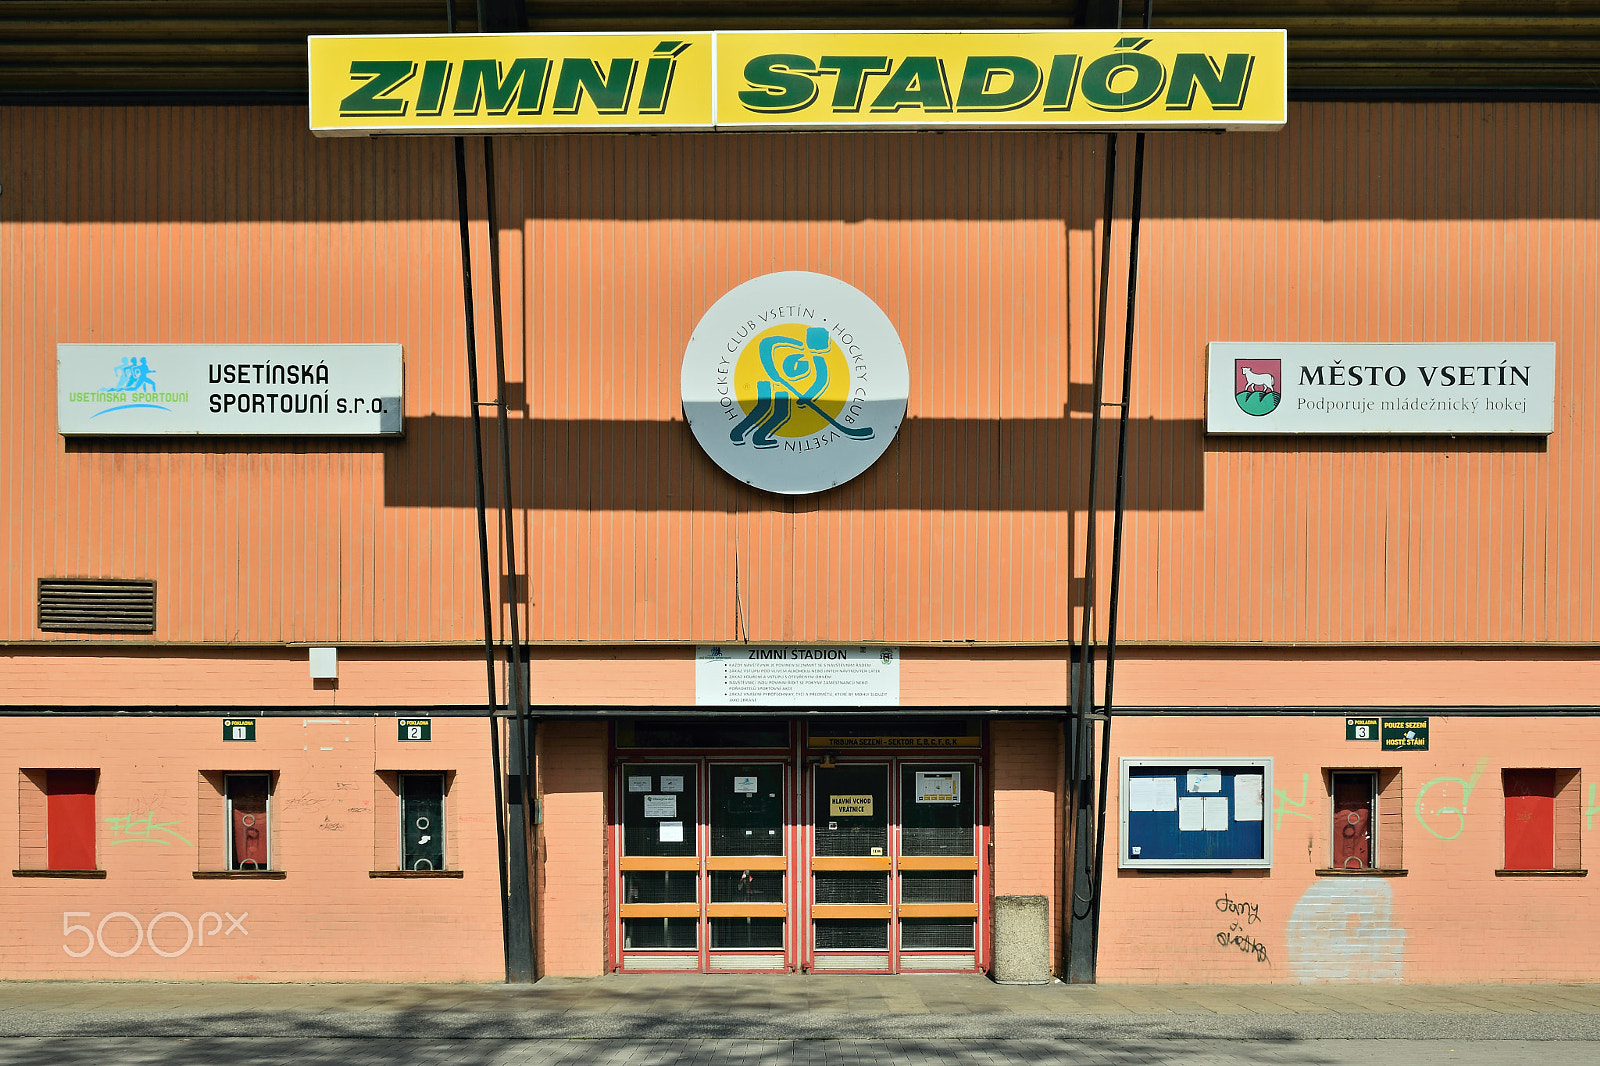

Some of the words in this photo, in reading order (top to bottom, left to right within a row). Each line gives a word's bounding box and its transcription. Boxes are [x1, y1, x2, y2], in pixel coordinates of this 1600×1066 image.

[339, 40, 692, 117] ZIMNÍ
[737, 36, 1256, 113] STADIÓN
[716, 356, 738, 420] HOCKEY
[728, 320, 756, 353] CLUB
[758, 304, 816, 322] VSETÍN
[832, 322, 868, 382] HOCKEY
[209, 360, 328, 384] VSETÍNSKÁ
[1298, 359, 1406, 387] MĚSTO
[1418, 359, 1531, 387] VSETÍN
[70, 390, 126, 402] VSETÍNSKÁ
[132, 390, 188, 402] SPORTOVNÍ
[209, 390, 328, 414] SPORTOVNÍ
[336, 396, 388, 414] s.r.o.
[844, 388, 866, 424] CLUB
[1297, 397, 1375, 413] Podporuje
[1380, 396, 1478, 414] mládežnický
[1485, 397, 1528, 413] hokej
[784, 430, 840, 454] VSETÍN
[748, 647, 788, 660] ZIMNÍ
[791, 649, 847, 660] STADION
[237, 728, 242, 738] 1
[411, 728, 418, 738] 2
[1359, 727, 1366, 737] 3
